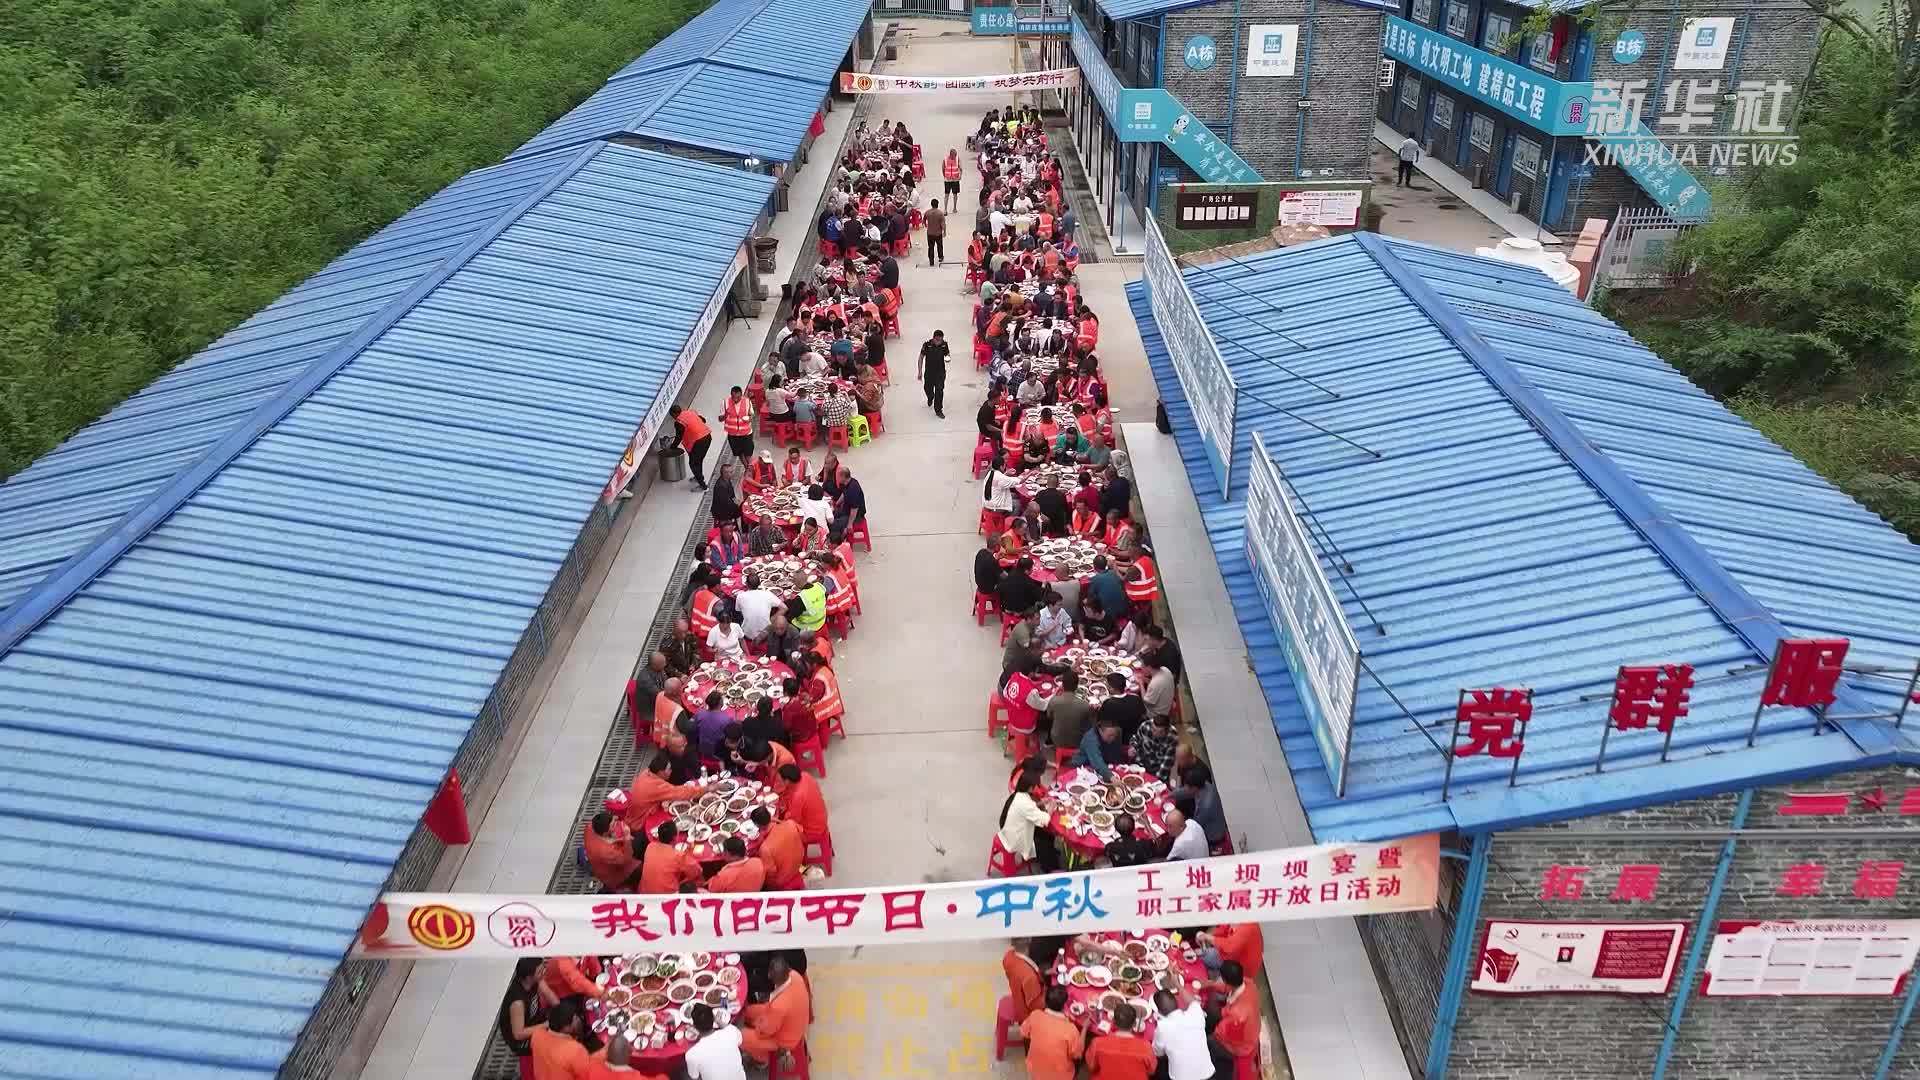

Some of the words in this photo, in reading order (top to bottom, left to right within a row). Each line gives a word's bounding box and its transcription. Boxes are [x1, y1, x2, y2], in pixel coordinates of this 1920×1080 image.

[1187, 44, 1214, 61] A栋
[1615, 39, 1643, 56] B栋
[993, 73, 1065, 88] 筑梦共前行
[1420, 38, 1473, 87] 创文明工地
[1477, 63, 1546, 121] 建精品工程
[1455, 637, 1920, 759] 党群服
[1136, 847, 1403, 893] 工地坝坝宴暨
[1540, 864, 1661, 902] 拓展
[1775, 860, 1905, 898] 幸福
[1135, 874, 1402, 919] 职工家属开放日活动
